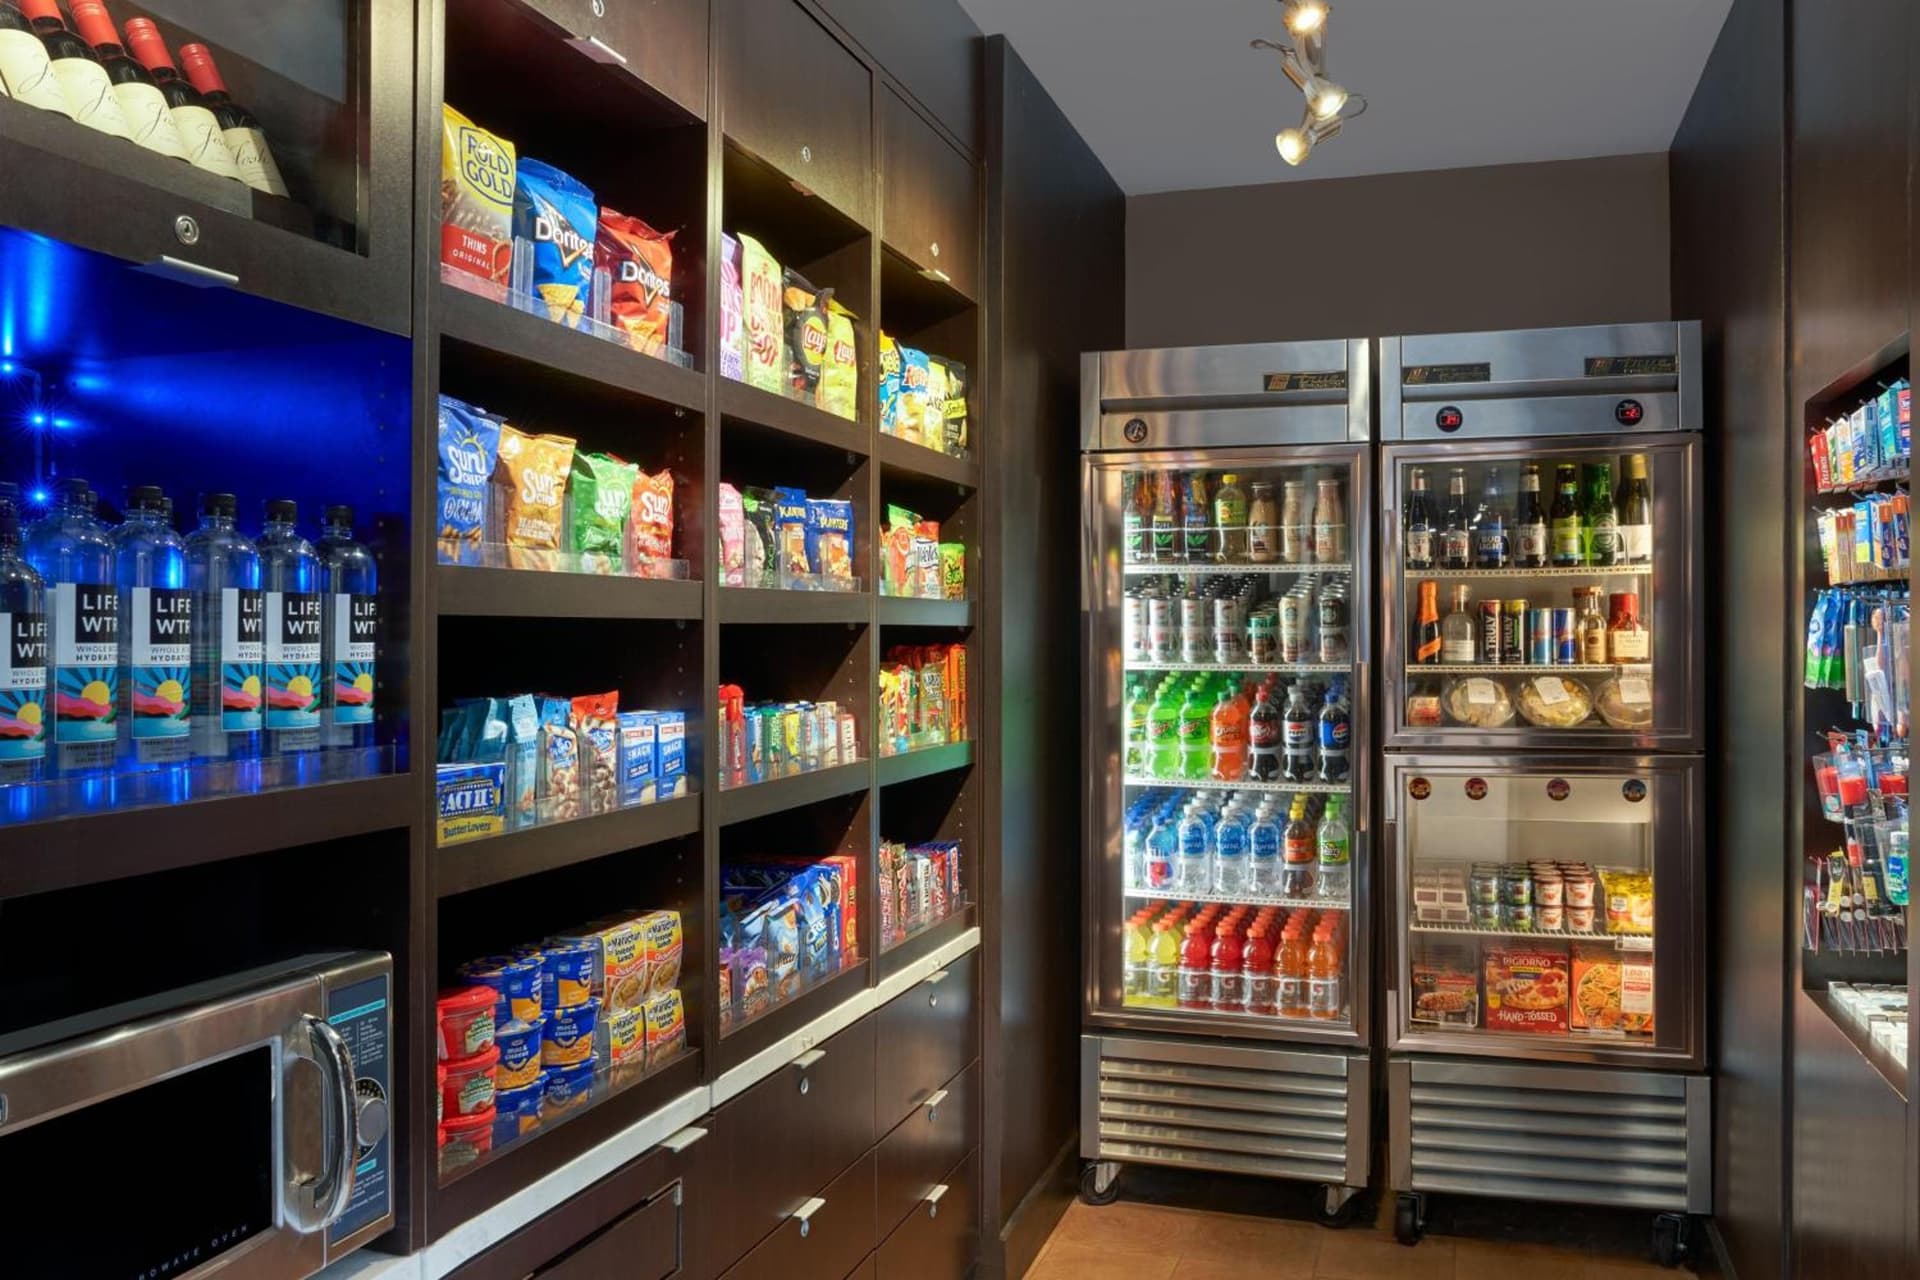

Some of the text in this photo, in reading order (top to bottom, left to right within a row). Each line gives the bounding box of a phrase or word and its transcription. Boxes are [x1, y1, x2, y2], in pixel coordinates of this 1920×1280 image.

[466, 161, 512, 199] GOLD
[462, 234, 488, 255] THINS
[535, 218, 595, 260] Doritos
[452, 248, 493, 271] ORIGINAL
[621, 261, 670, 298] Doritos
[156, 598, 190, 613] LIFE
[287, 601, 320, 615] LIFE
[287, 620, 320, 635] WTR
[1486, 615, 1497, 651] TRULY
[1503, 615, 1513, 648] TRULY
[445, 788, 488, 813] ACT II
[611, 930, 641, 948] Maruchan
[1157, 968, 1171, 982] G
[1186, 973, 1199, 987] G
[1221, 975, 1235, 989] G
[1252, 977, 1266, 991] G
[1281, 979, 1295, 994] G
[205, 1224, 238, 1245] OVEN
